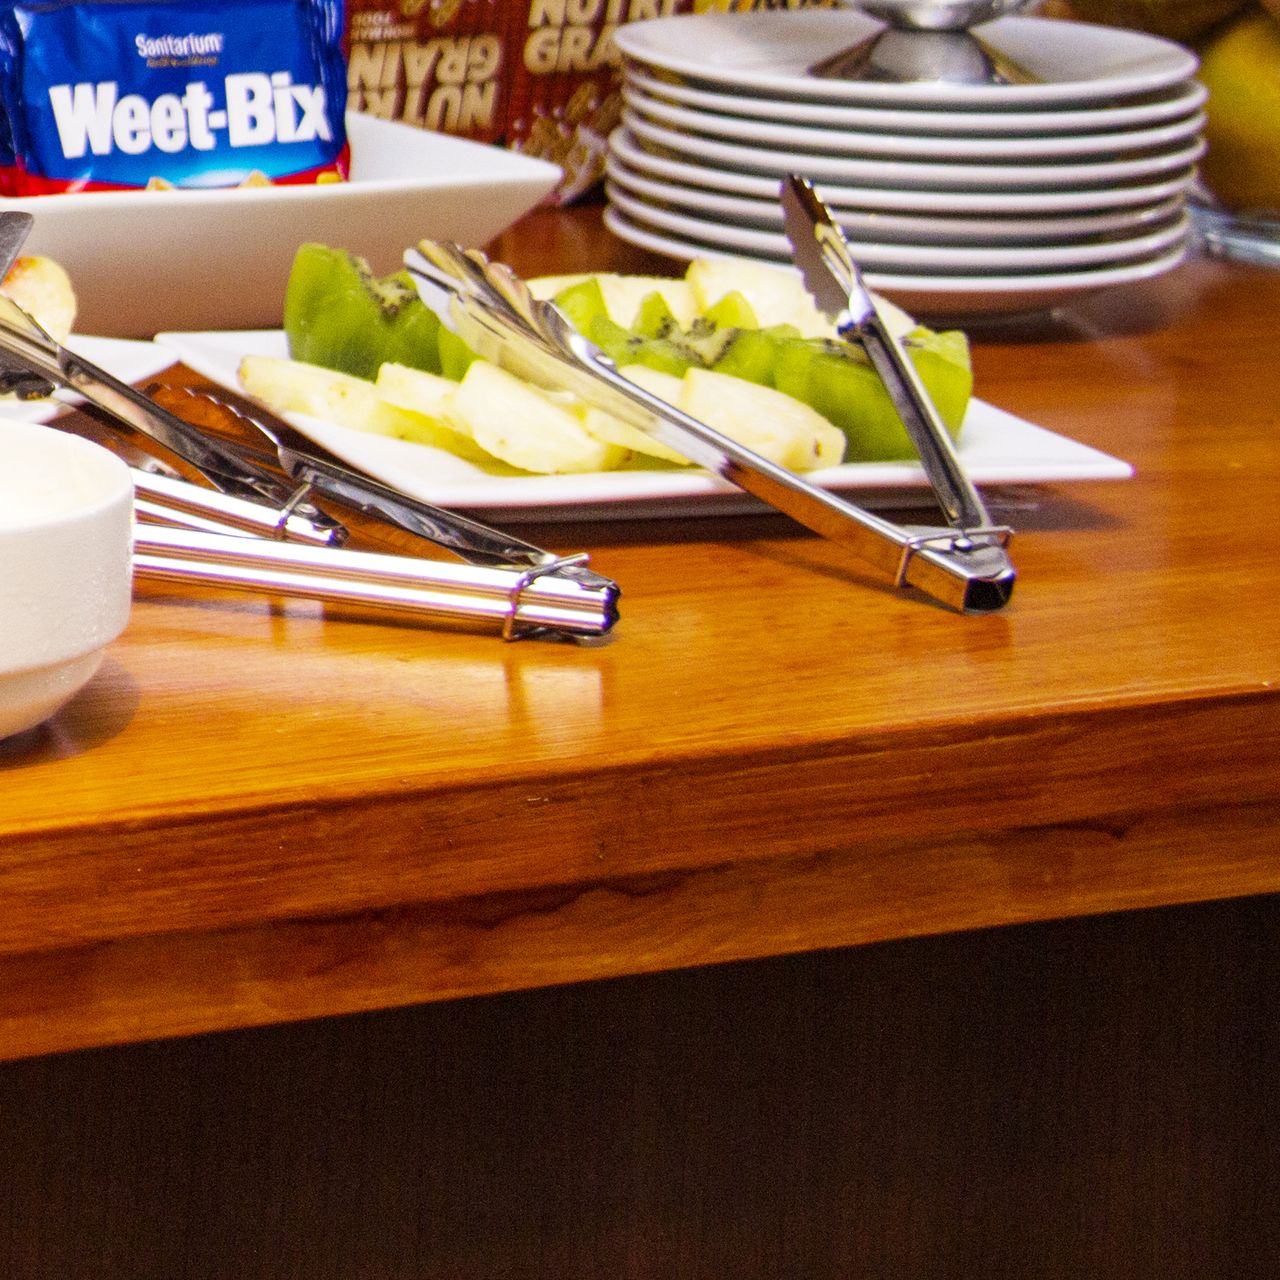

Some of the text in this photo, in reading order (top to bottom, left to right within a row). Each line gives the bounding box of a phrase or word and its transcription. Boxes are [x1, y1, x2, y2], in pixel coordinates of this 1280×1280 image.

[135, 32, 224, 58] Sanitarium
[347, 33, 502, 88] GRAIN
[523, 24, 624, 75] GRA
[48, 71, 333, 160] Weet-Bix
